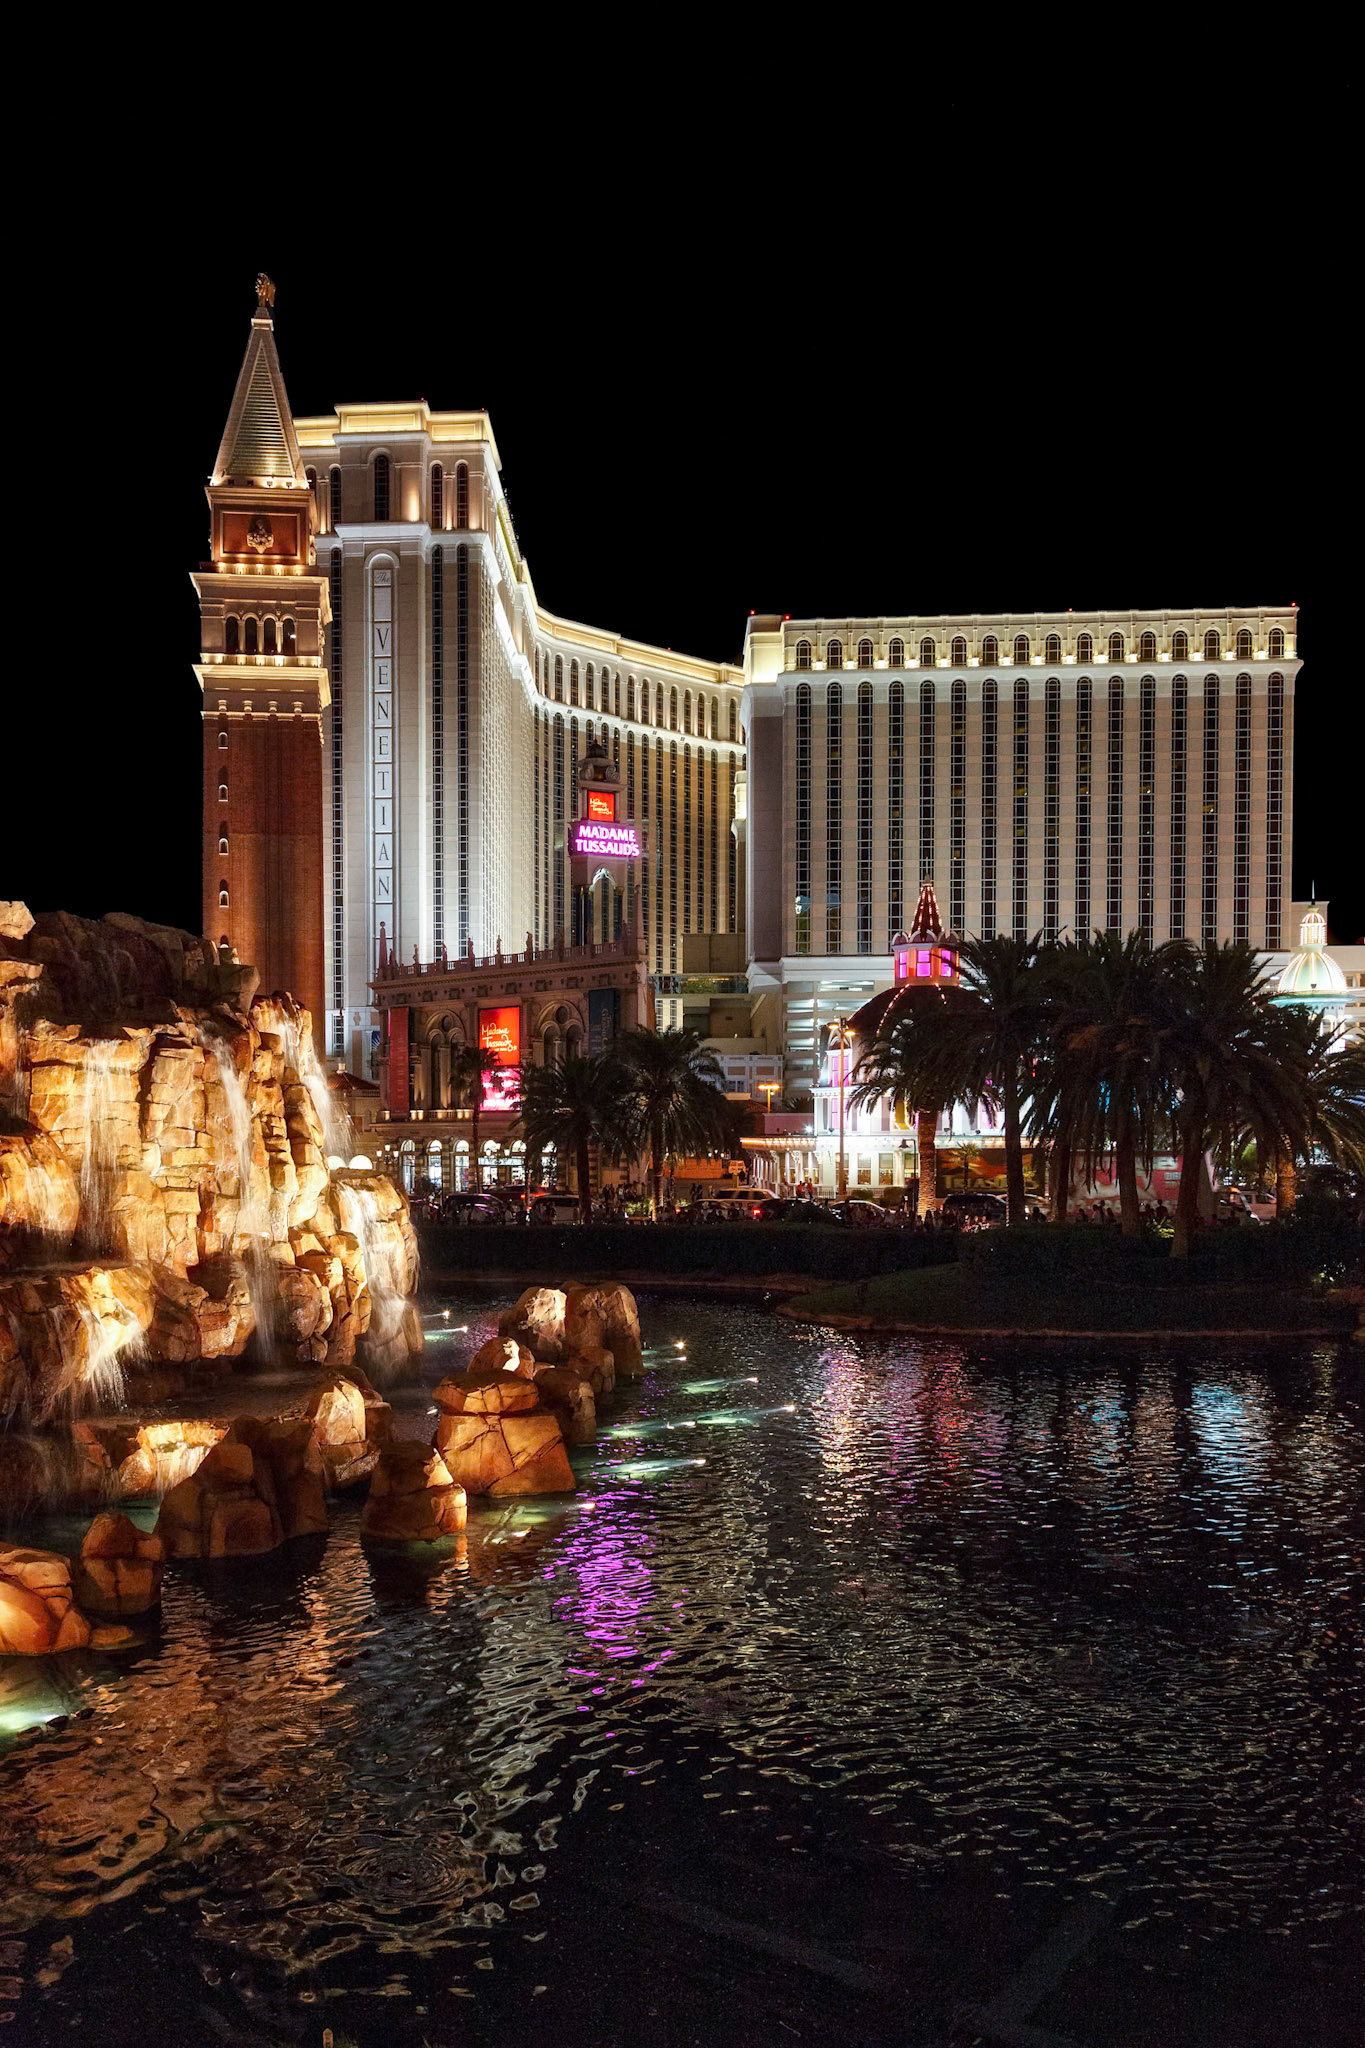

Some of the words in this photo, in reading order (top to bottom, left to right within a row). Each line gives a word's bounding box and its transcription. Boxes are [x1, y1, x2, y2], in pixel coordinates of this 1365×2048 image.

[375, 626, 390, 896] VENETIAN
[579, 825, 636, 841] MADAME
[481, 1022, 510, 1037] Madame
